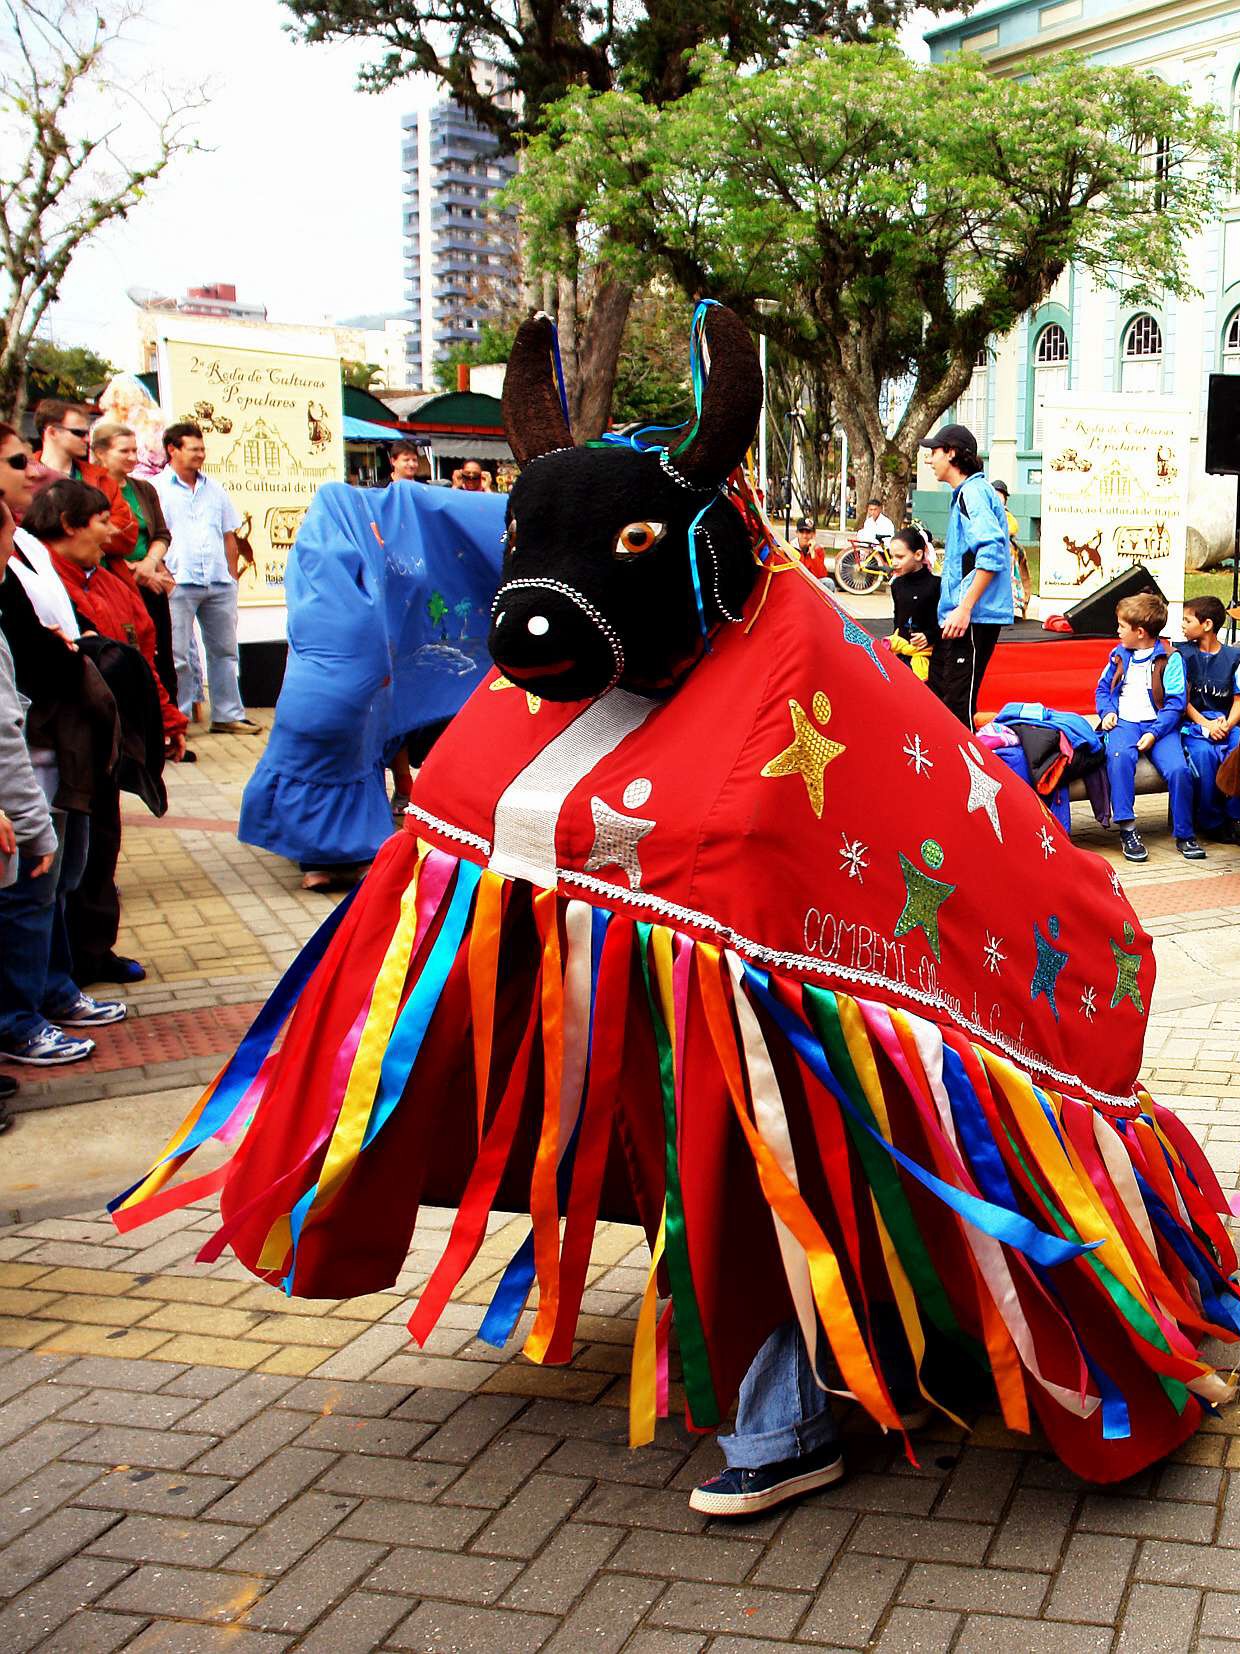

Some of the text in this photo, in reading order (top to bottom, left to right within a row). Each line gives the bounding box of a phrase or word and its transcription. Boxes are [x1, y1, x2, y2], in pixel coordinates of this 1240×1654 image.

[247, 369, 262, 383] de
[265, 368, 327, 388] Culturas
[221, 382, 297, 411] Populares
[245, 479, 291, 493] Cultural
[294, 481, 306, 493] de
[804, 908, 908, 984] COMBEMI
